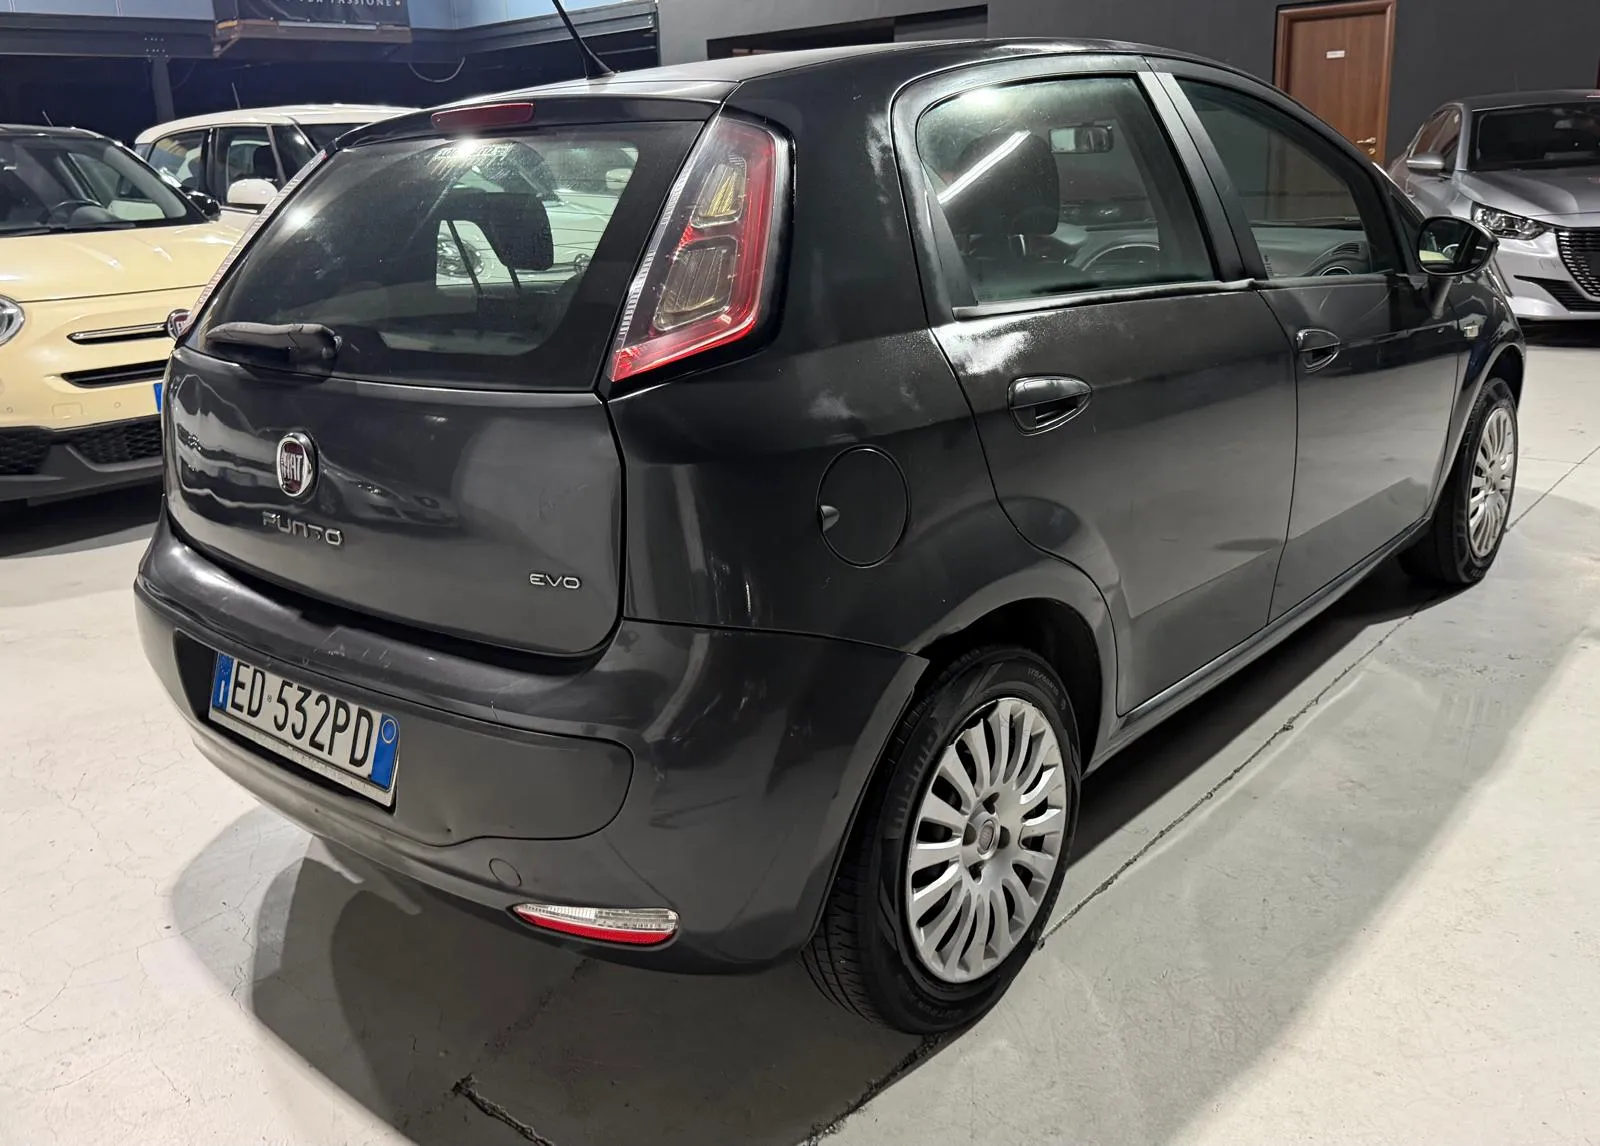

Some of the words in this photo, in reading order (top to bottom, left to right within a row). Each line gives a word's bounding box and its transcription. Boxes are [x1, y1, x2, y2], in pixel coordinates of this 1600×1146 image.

[262, 511, 342, 545] PUNTO
[529, 573, 580, 589] EVO
[230, 660, 266, 718] ED
[273, 679, 374, 768] 532PD
